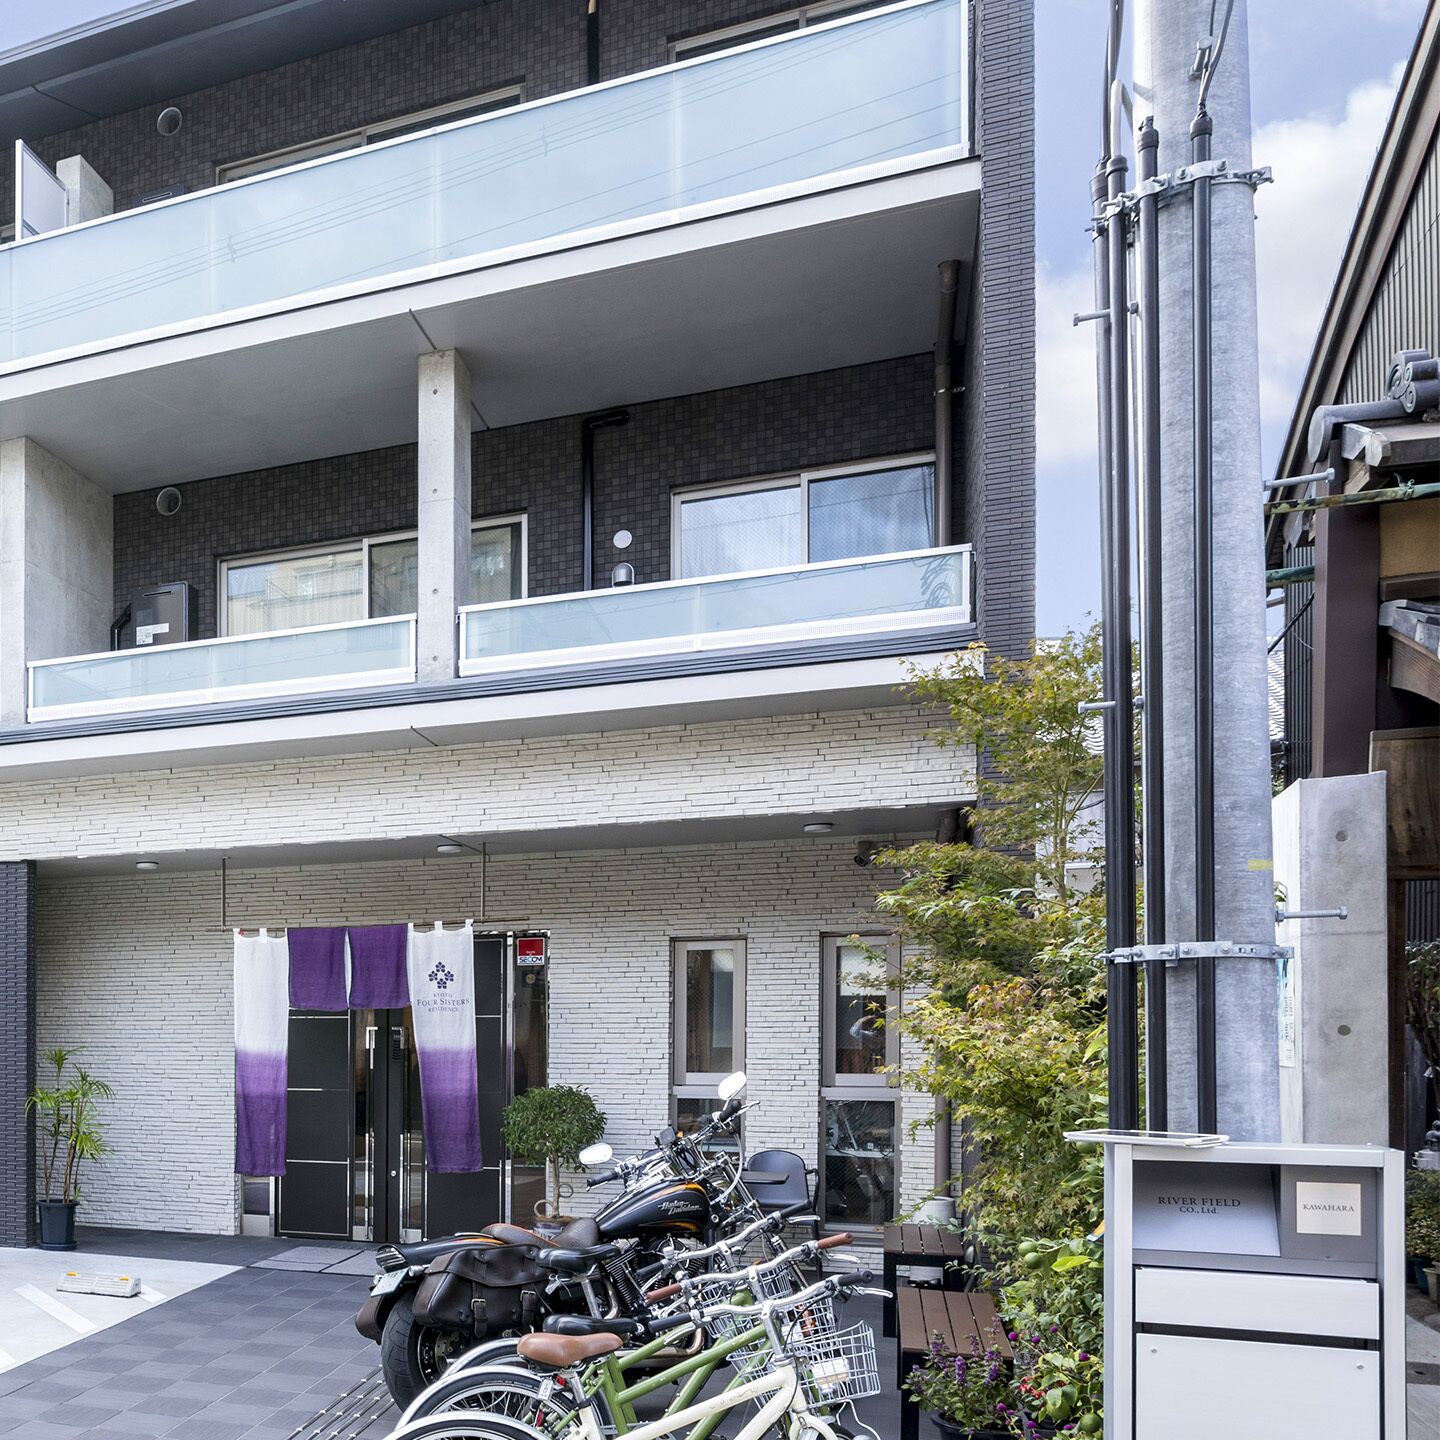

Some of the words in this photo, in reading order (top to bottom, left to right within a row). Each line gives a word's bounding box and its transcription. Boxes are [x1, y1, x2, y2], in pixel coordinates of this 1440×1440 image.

[416, 999, 438, 1007] FOUR
[439, 997, 470, 1006] SISTERS
[1158, 1196, 1198, 1206] RIVER
[1201, 1197, 1241, 1207] FIELD
[1303, 1203, 1354, 1212] KAWAHARA
